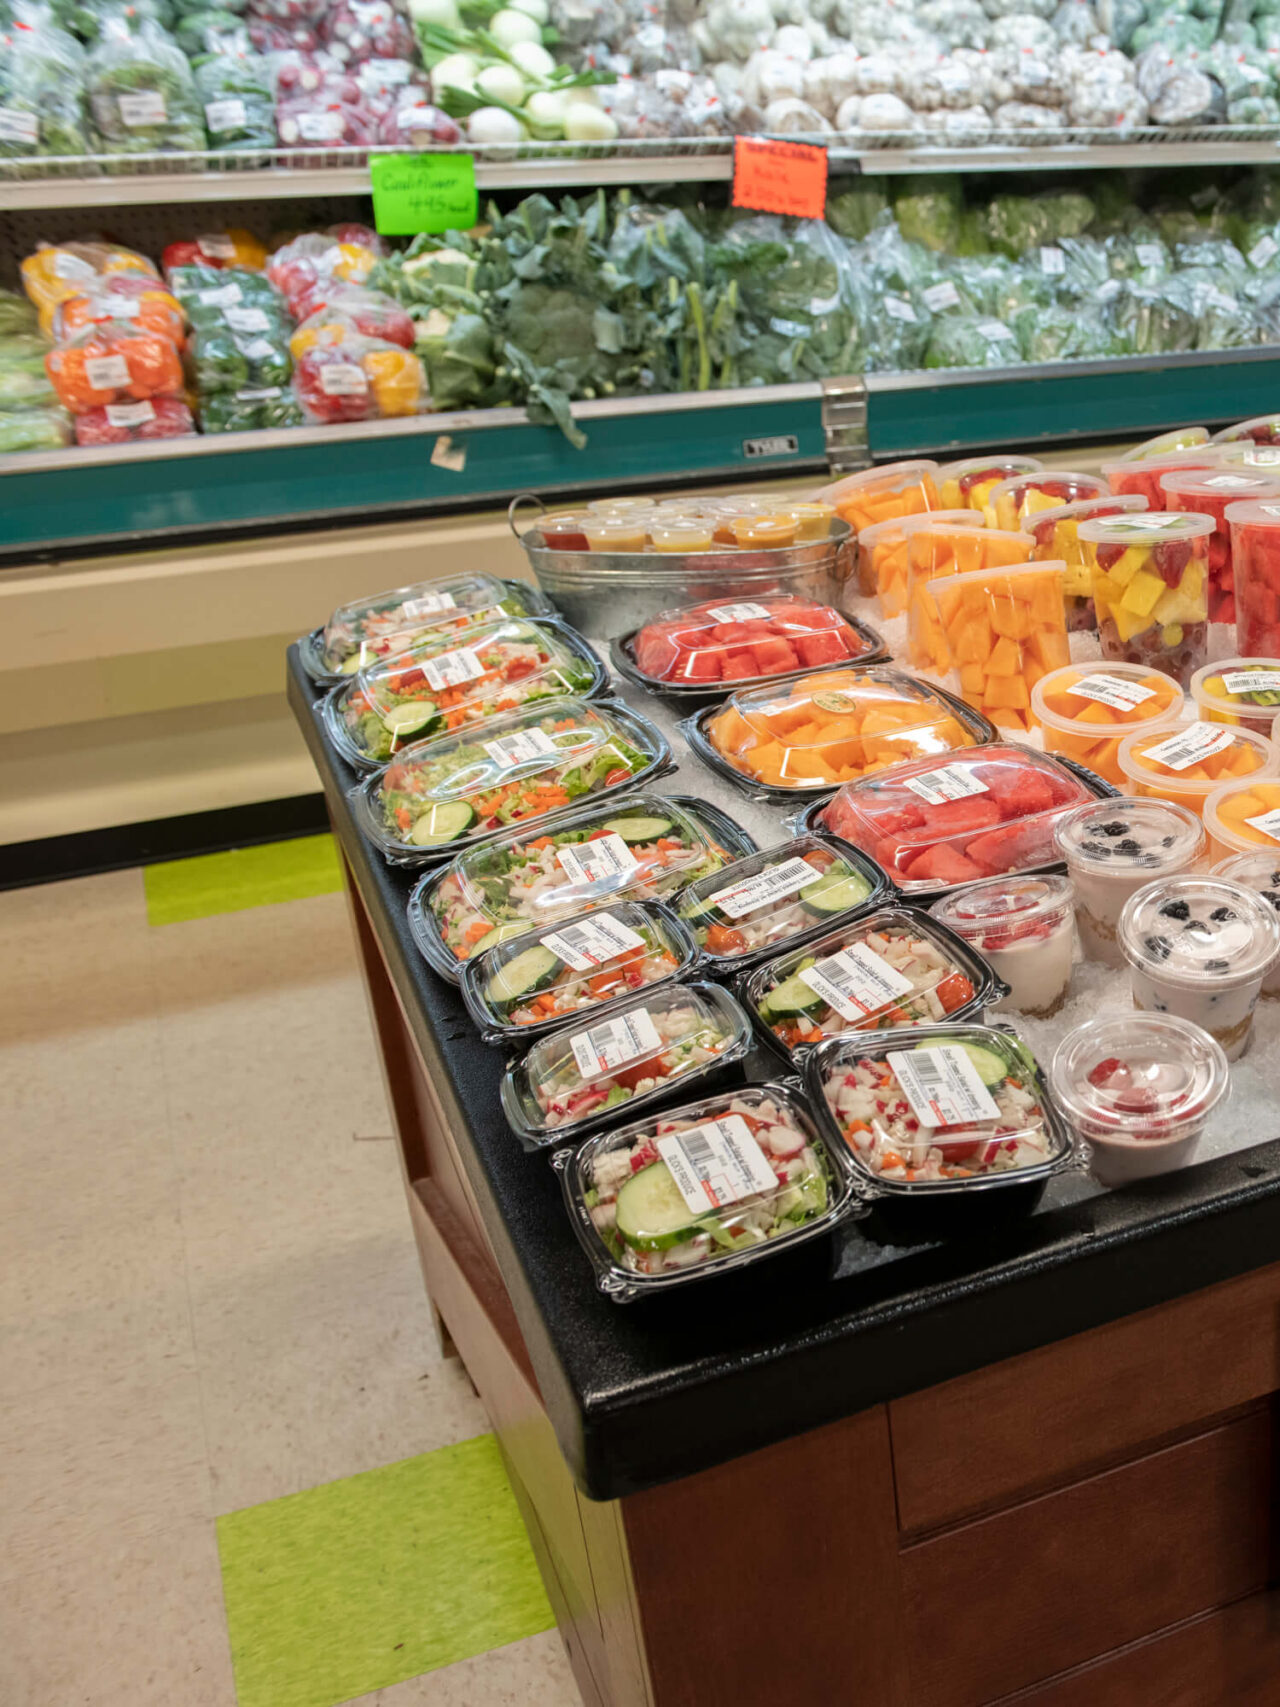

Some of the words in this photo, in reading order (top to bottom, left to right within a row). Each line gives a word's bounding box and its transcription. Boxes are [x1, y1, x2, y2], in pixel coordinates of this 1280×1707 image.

[822, 990, 848, 1010] PRODUCE
[905, 1086, 928, 1110] PRODUCE
[673, 1170, 698, 1196] PRODUCE
